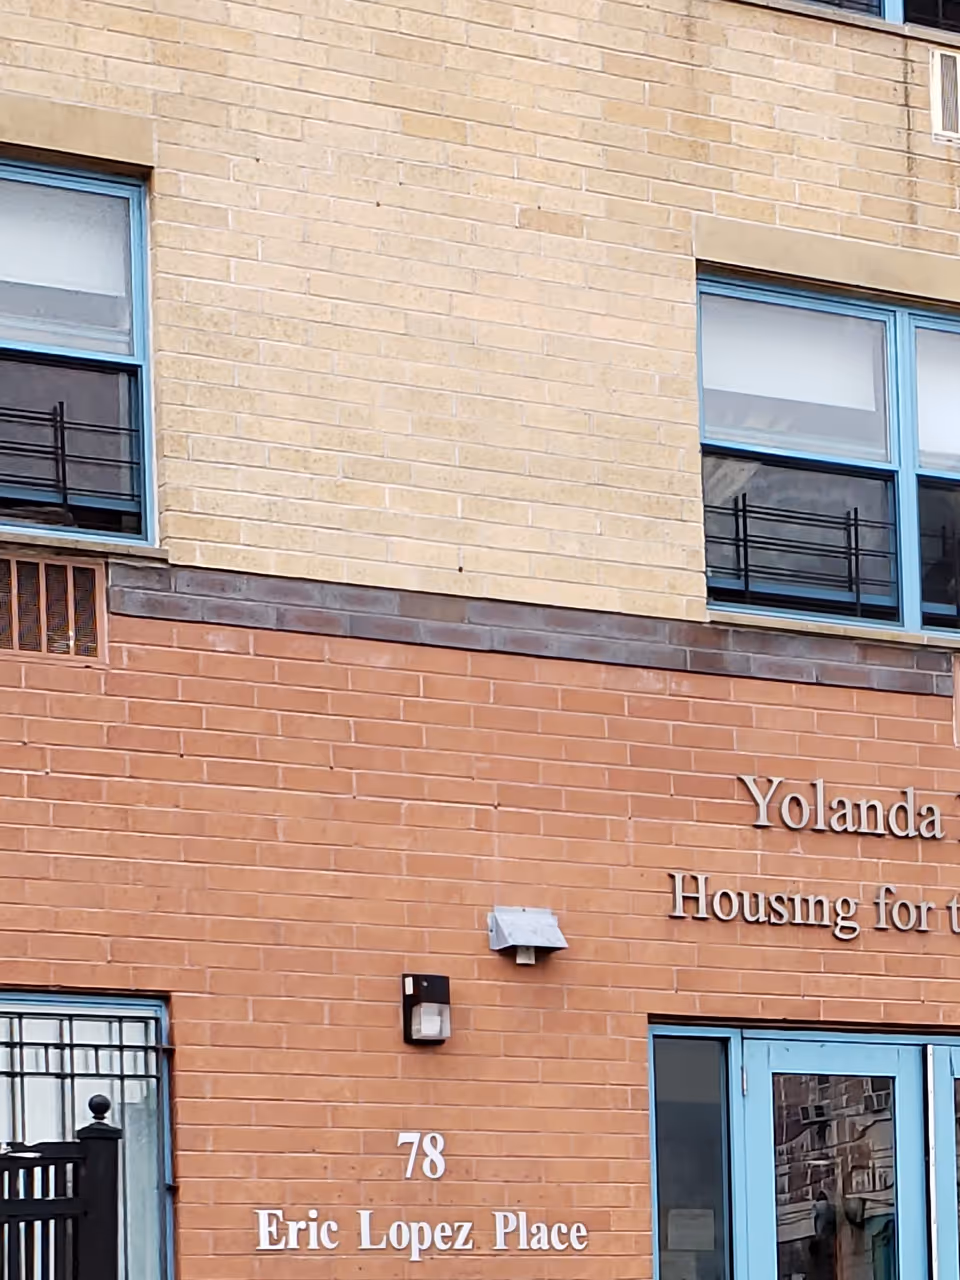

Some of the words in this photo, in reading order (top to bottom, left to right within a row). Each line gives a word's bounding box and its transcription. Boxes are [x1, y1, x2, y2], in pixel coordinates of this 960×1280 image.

[736, 774, 946, 840] Yolanda
[667, 871, 860, 942] Housing
[873, 885, 937, 933] for
[396, 1131, 446, 1180] 78
[254, 1208, 339, 1251] Eric
[356, 1209, 474, 1262] Lopez
[491, 1210, 589, 1252] Place
